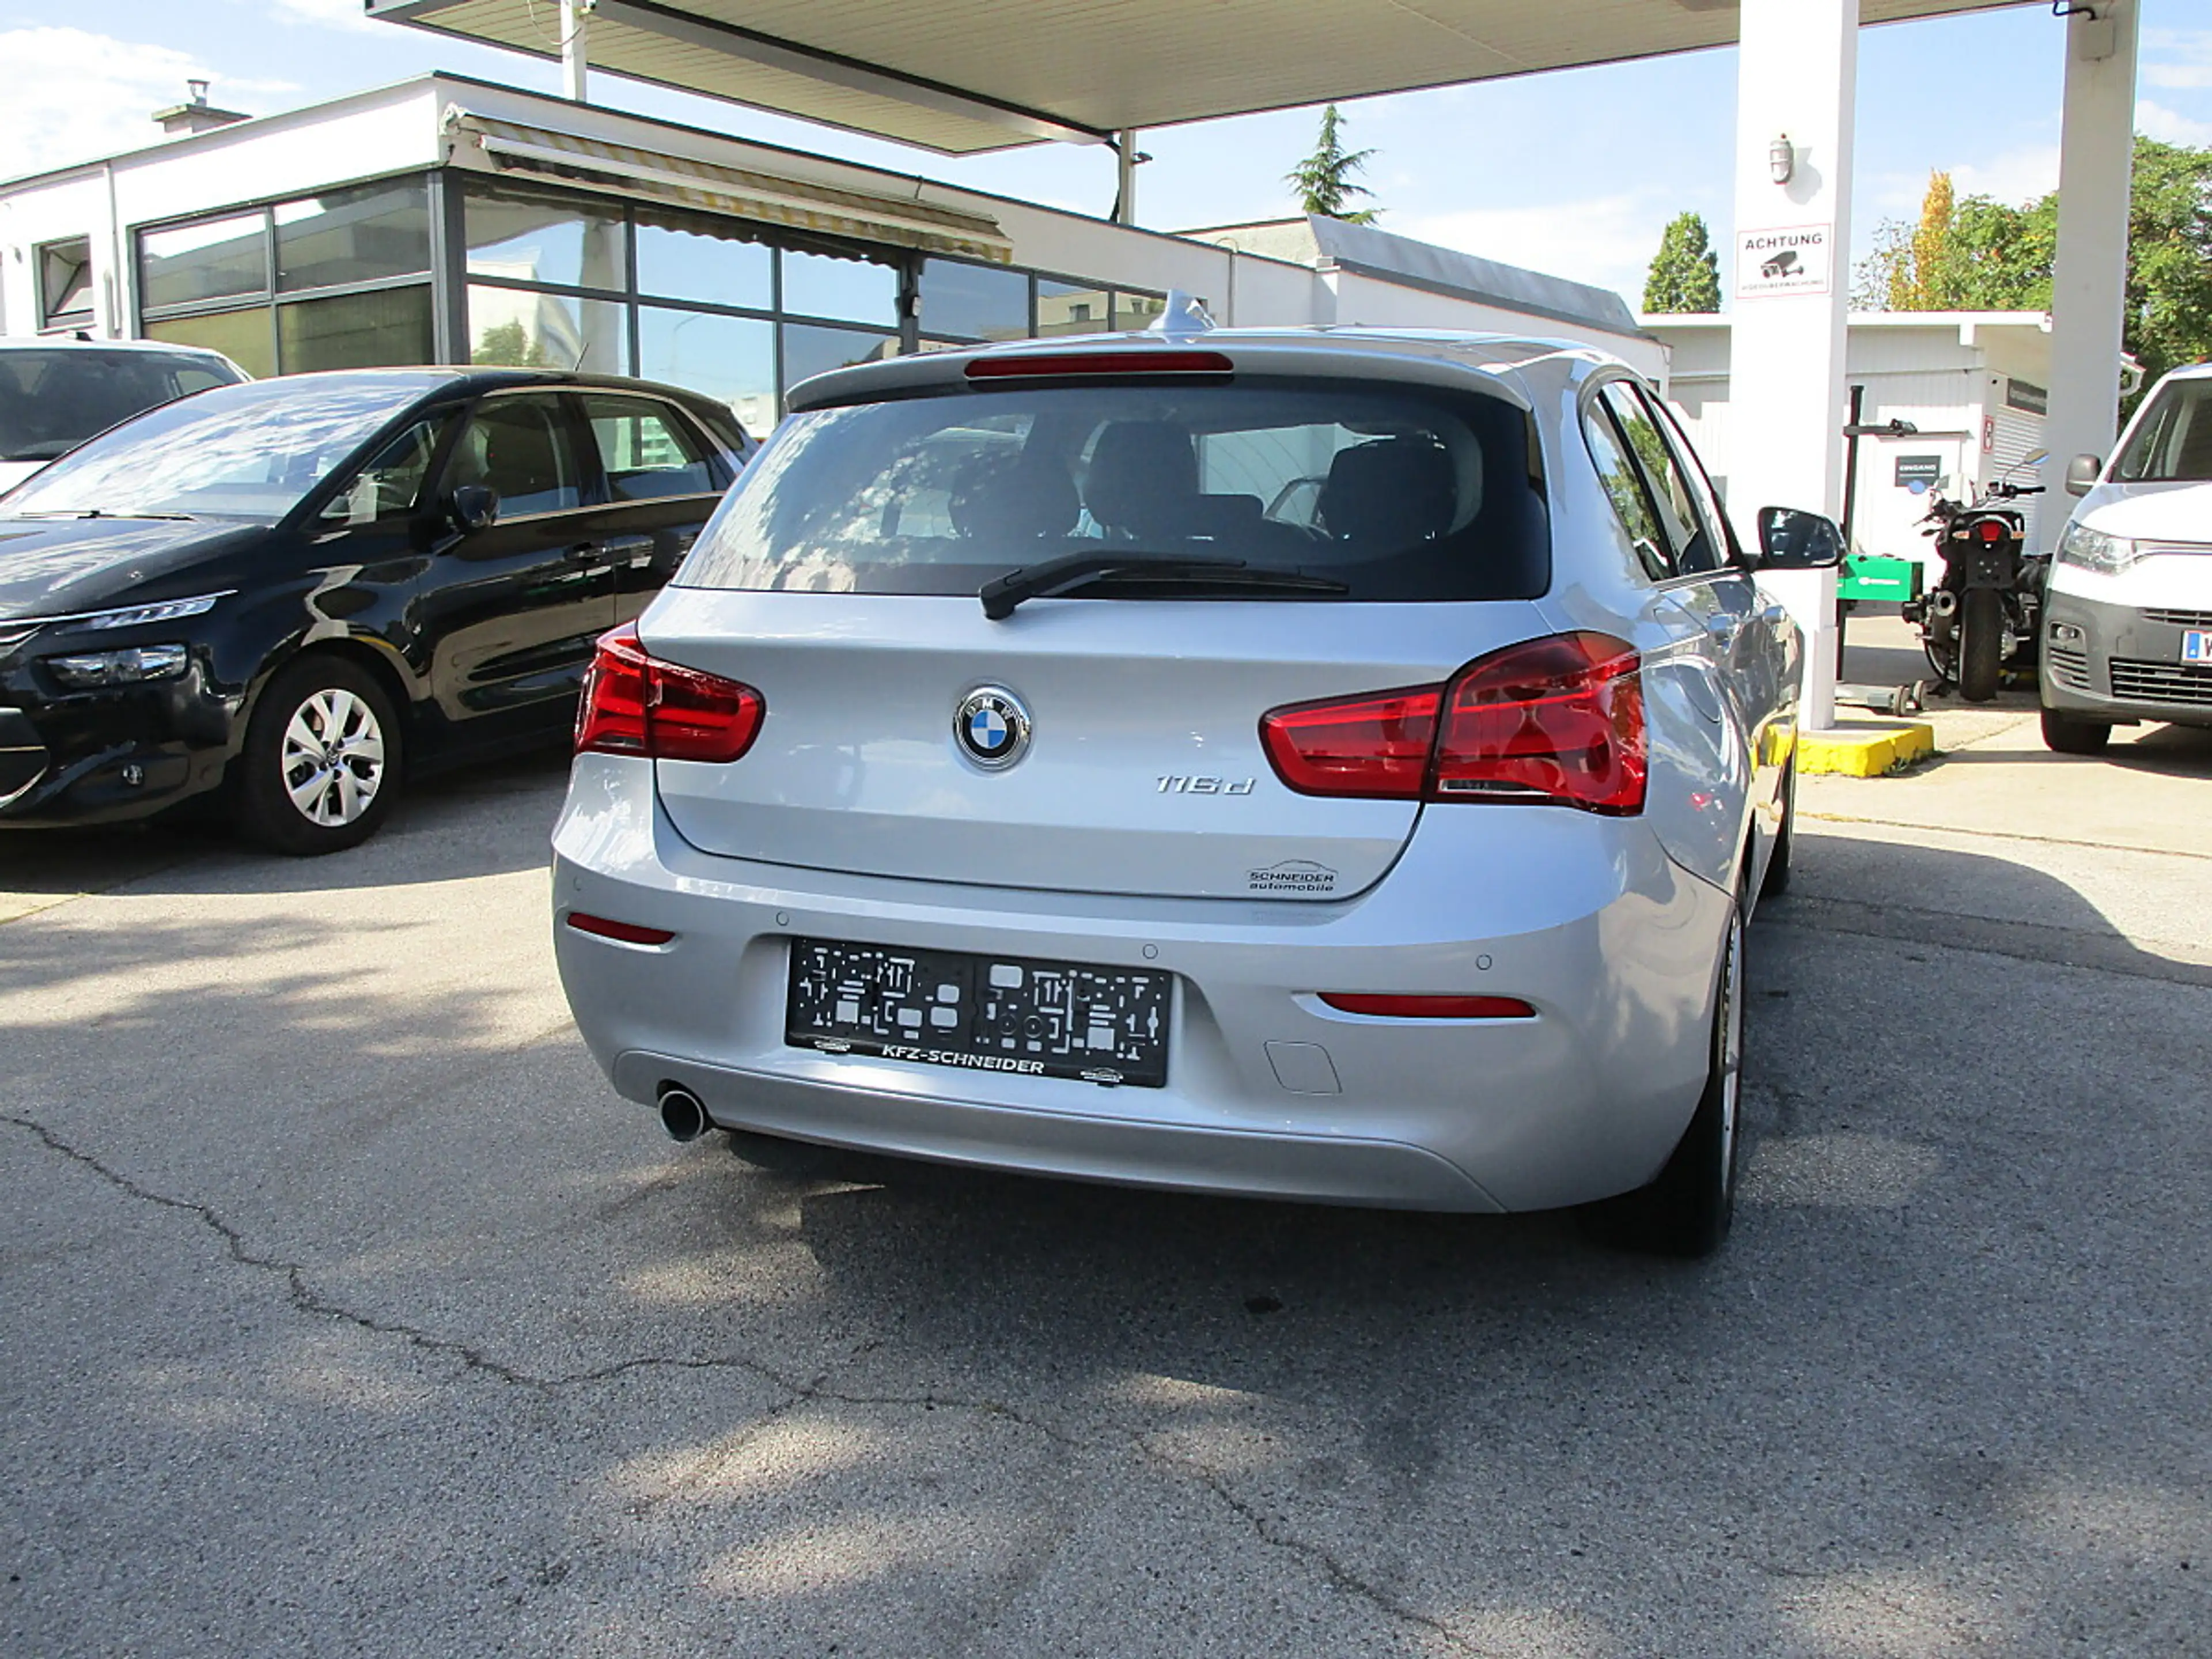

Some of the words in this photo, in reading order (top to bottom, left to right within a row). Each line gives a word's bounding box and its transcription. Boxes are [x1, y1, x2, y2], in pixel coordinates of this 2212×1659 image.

[1745, 233, 1823, 250] ACHTUNG
[964, 697, 1015, 720] BMW
[1157, 775, 1256, 796] 116d
[1249, 872, 1334, 882] SCHNEIDER
[1249, 882, 1334, 892] automobile
[881, 1044, 1045, 1074] KFZ-SCHNEIDER
